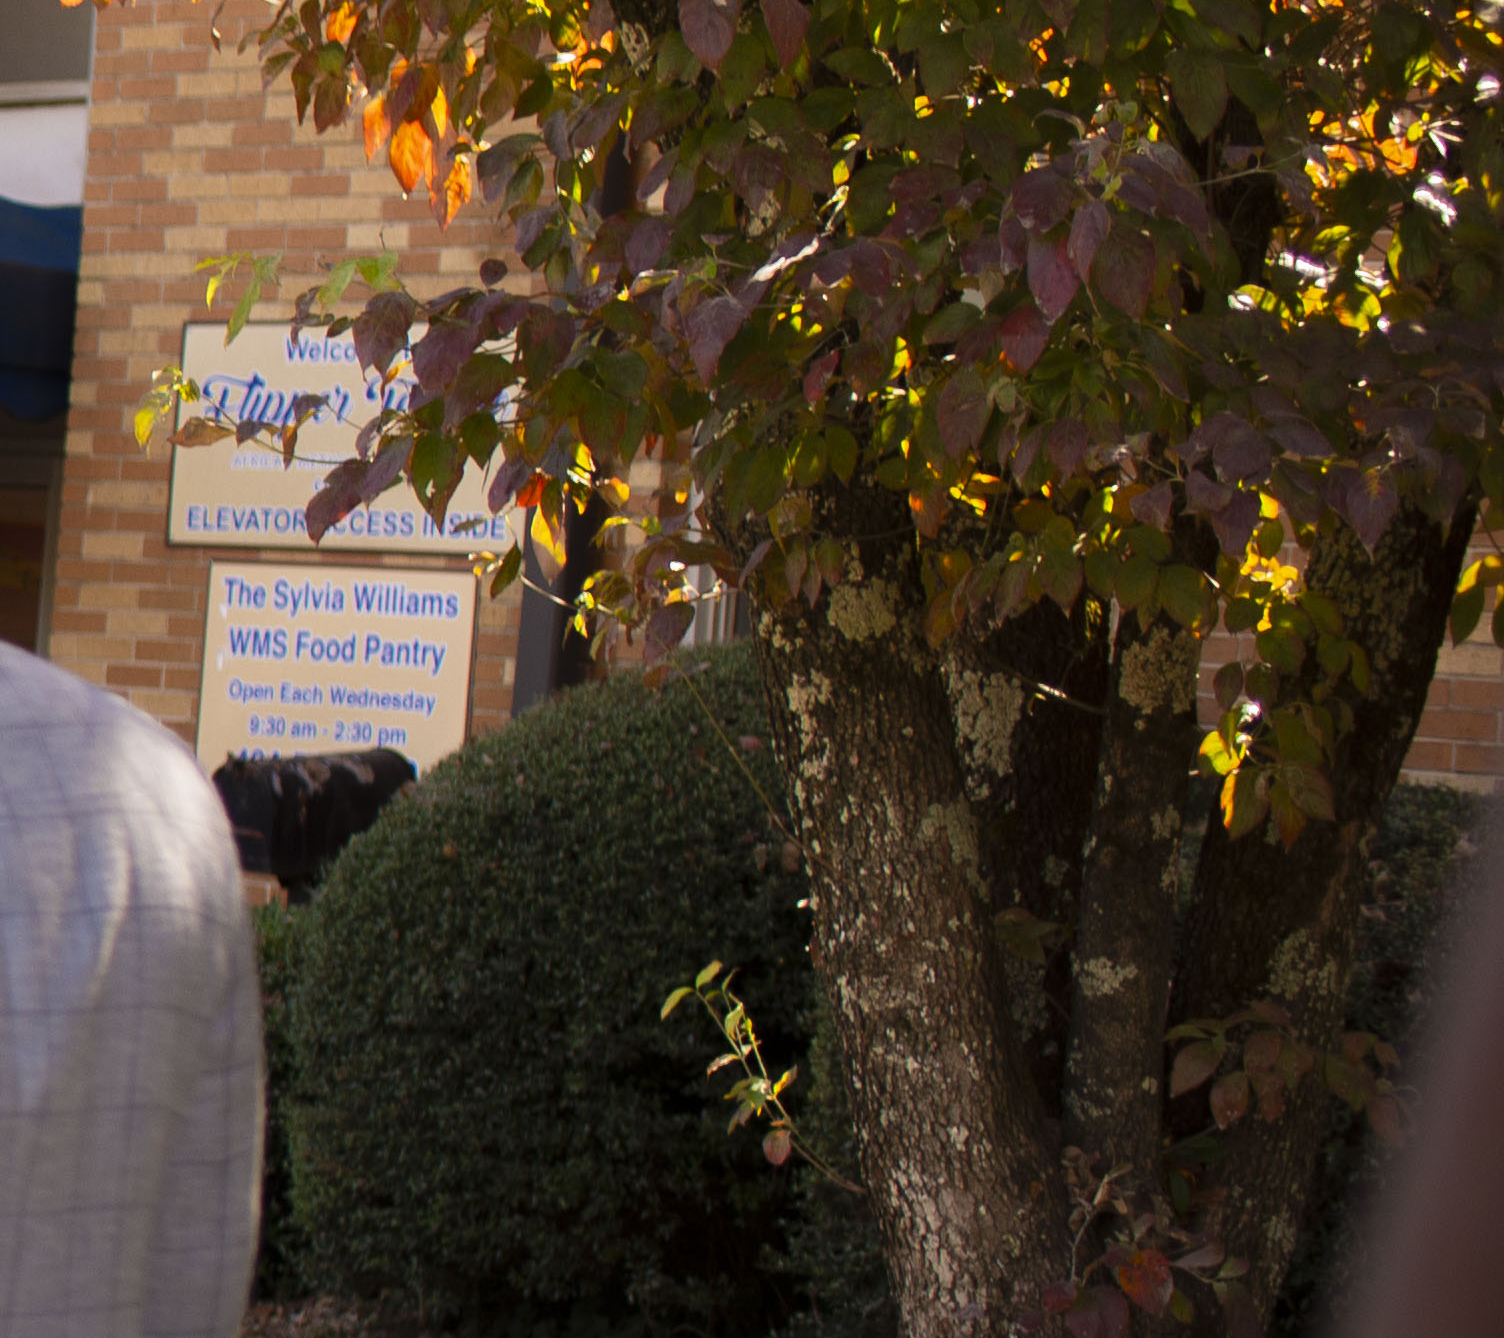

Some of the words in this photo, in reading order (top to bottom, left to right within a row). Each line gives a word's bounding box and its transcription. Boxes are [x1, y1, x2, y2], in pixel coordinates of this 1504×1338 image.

[188, 506, 306, 532] ELEVATOR
[225, 577, 266, 608] The
[274, 579, 344, 616] Sylvia
[354, 583, 458, 618] Williams
[229, 627, 287, 657] WMS
[296, 631, 356, 662] Food
[365, 635, 446, 675] Pantry
[229, 679, 273, 704] Open
[281, 684, 322, 704] Each
[330, 685, 436, 717] Wednesday
[249, 714, 285, 736] 9:30
[290, 722, 317, 739] am
[334, 721, 372, 742] 2:30
[378, 727, 406, 747] pm
